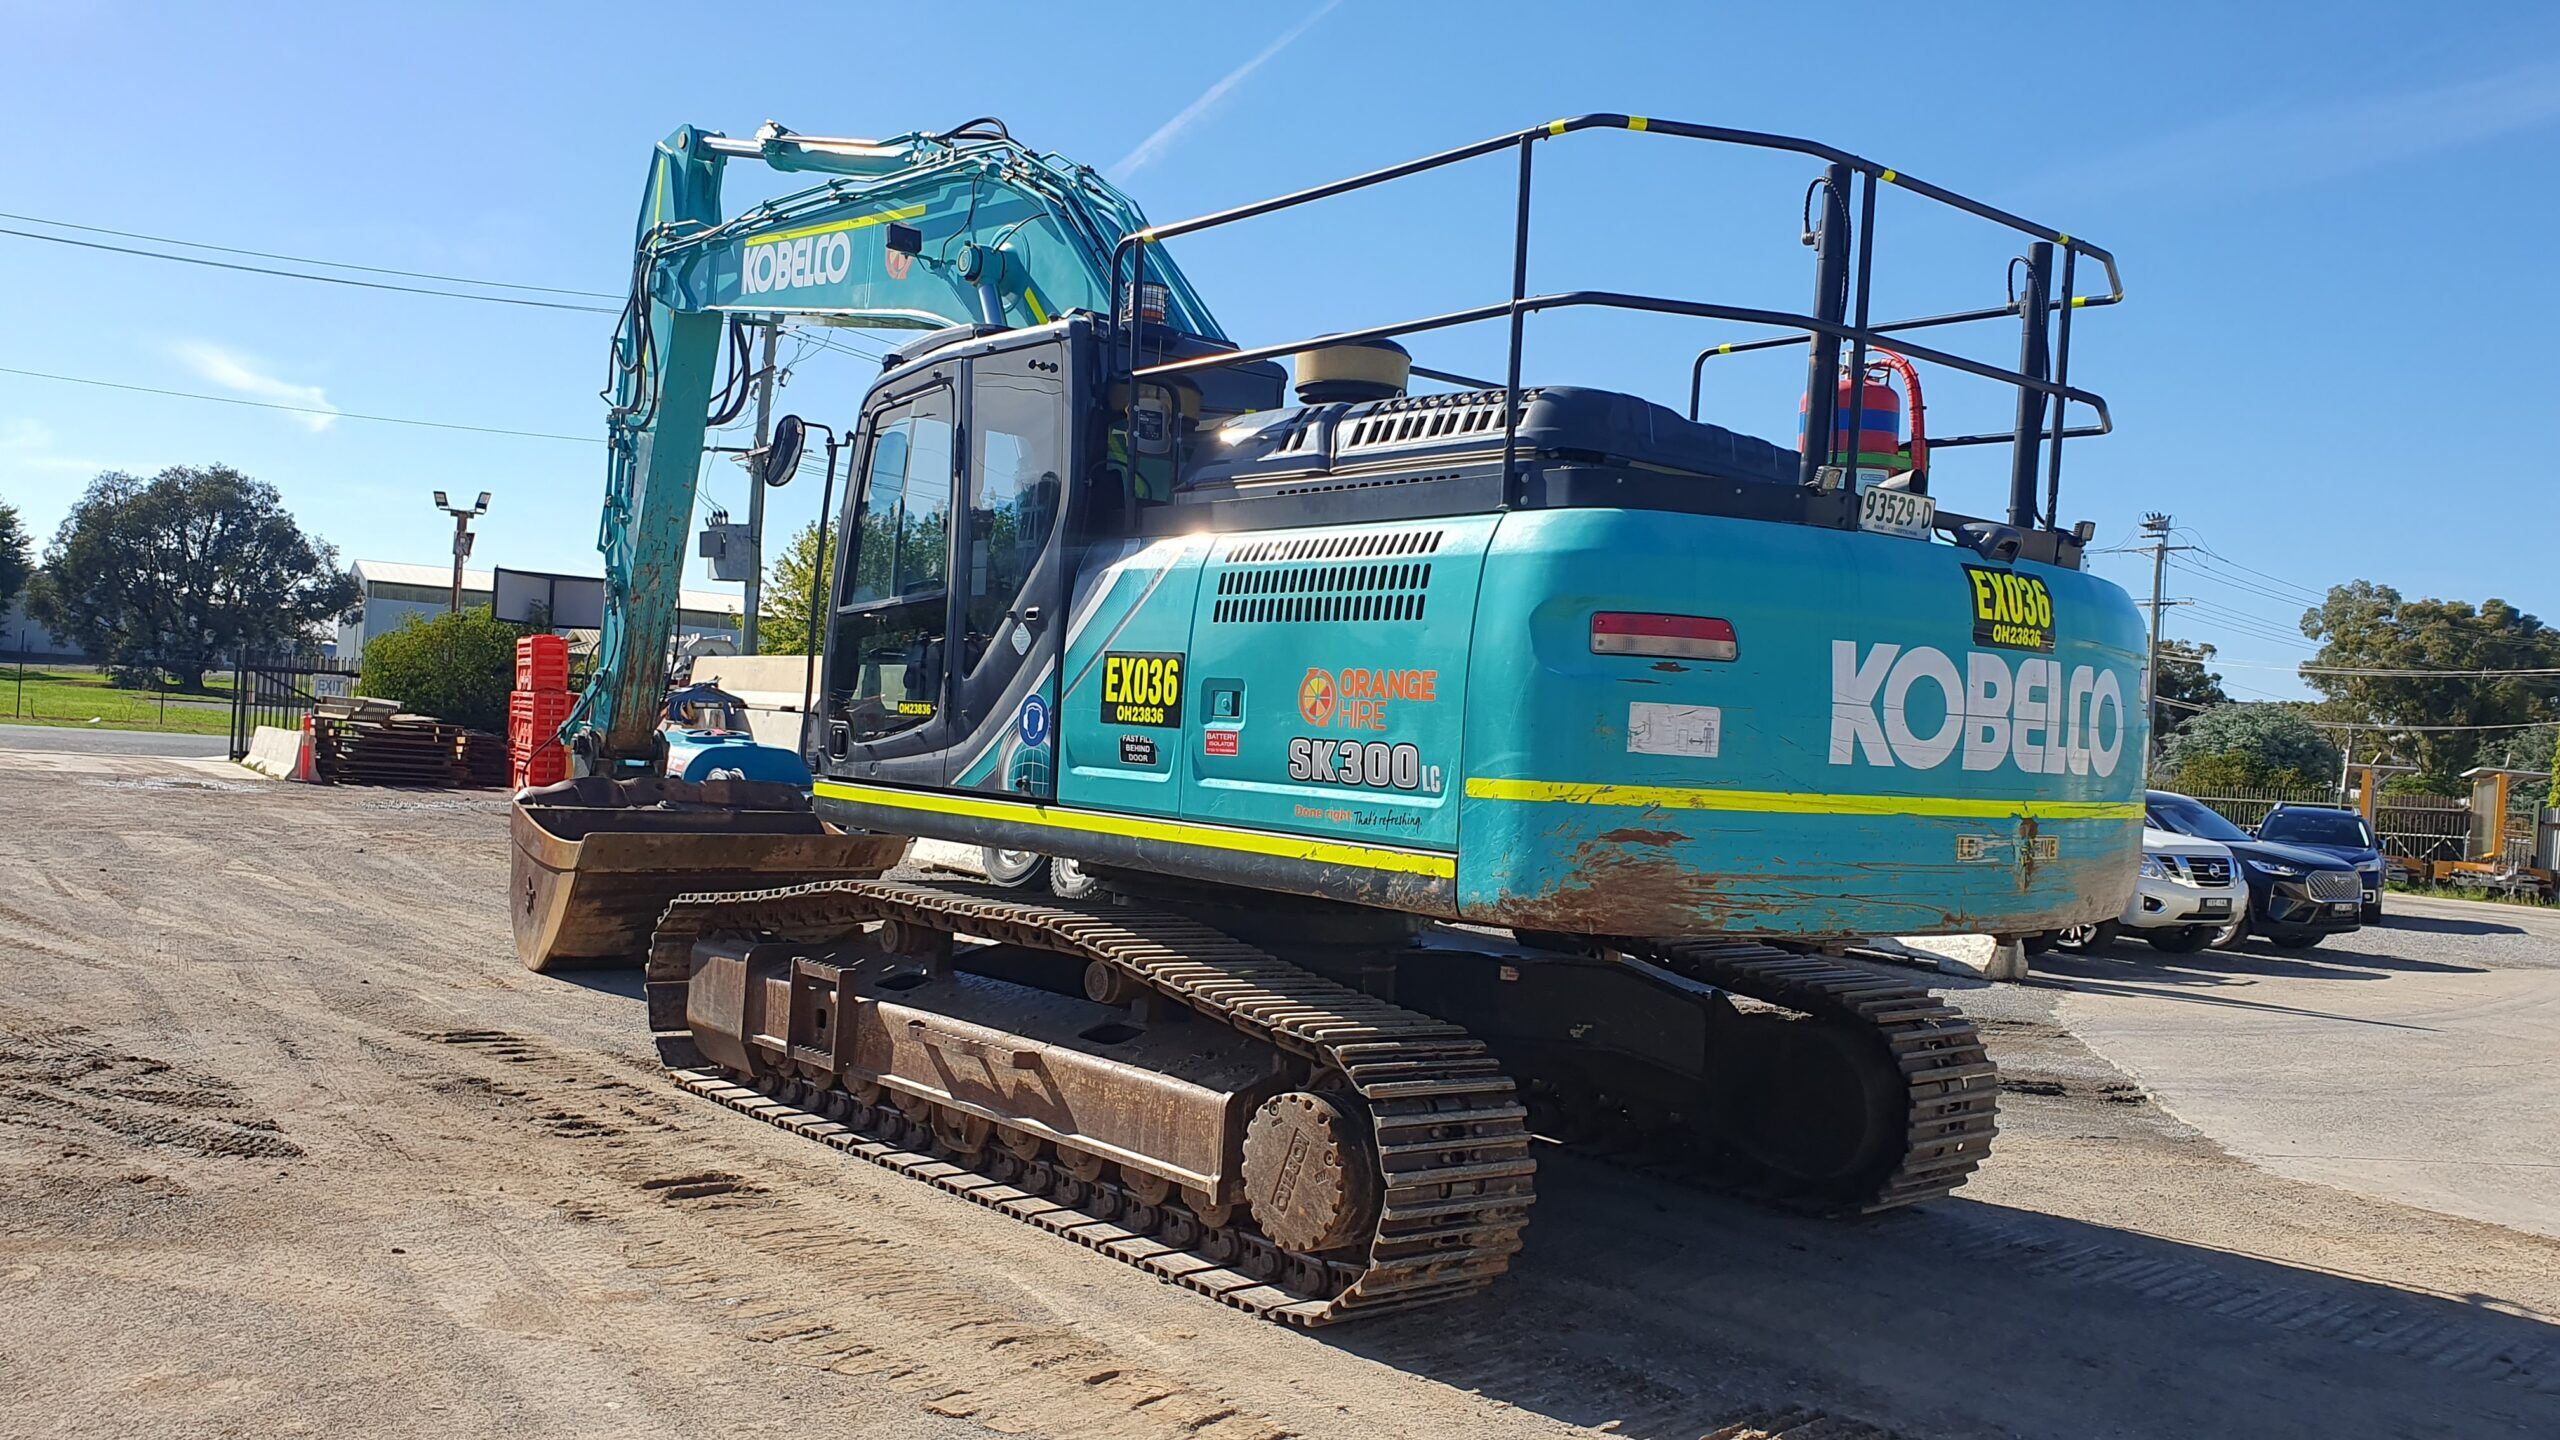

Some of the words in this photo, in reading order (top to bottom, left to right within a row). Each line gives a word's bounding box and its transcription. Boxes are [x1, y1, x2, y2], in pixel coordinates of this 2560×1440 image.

[741, 231, 851, 295] KOBELCO
[1969, 569, 2051, 629] EX036
[1992, 624, 2042, 647] OH23836
[317, 679, 343, 692] EXIT
[1105, 657, 1179, 706] EX036
[1339, 668, 1438, 701] ORANGE
[898, 703, 932, 715] OH23836
[1116, 705, 1164, 724] OH23836
[1338, 700, 1387, 731] HIRE
[1829, 640, 2124, 778] KOBELCO
[1122, 734, 1139, 743] FAST
[1207, 732, 1236, 741] BATTERY
[1125, 743, 1151, 753] BEHIND
[1128, 753, 1149, 762] DOOR
[1288, 737, 1420, 790] SK300
[1421, 765, 1441, 793] LC
[1294, 804, 1322, 818] Done
[1354, 810, 1378, 826] That's
